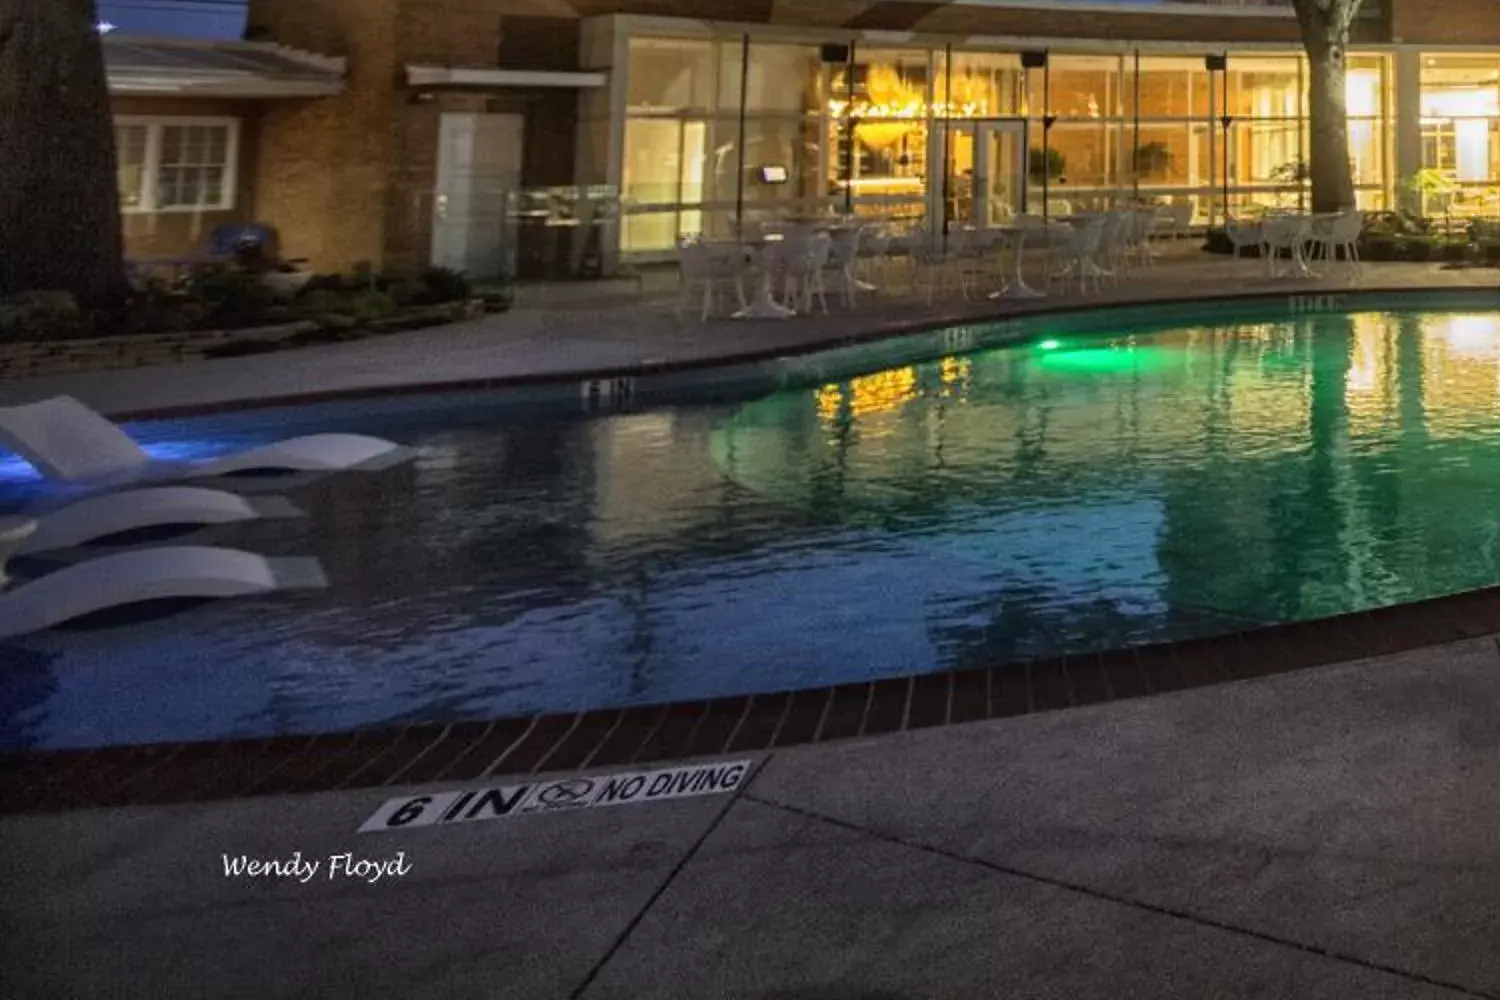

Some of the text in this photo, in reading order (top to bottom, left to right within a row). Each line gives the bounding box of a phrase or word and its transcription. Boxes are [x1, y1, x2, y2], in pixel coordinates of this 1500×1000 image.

[386, 765, 744, 827] 6 IN NO DIVING
